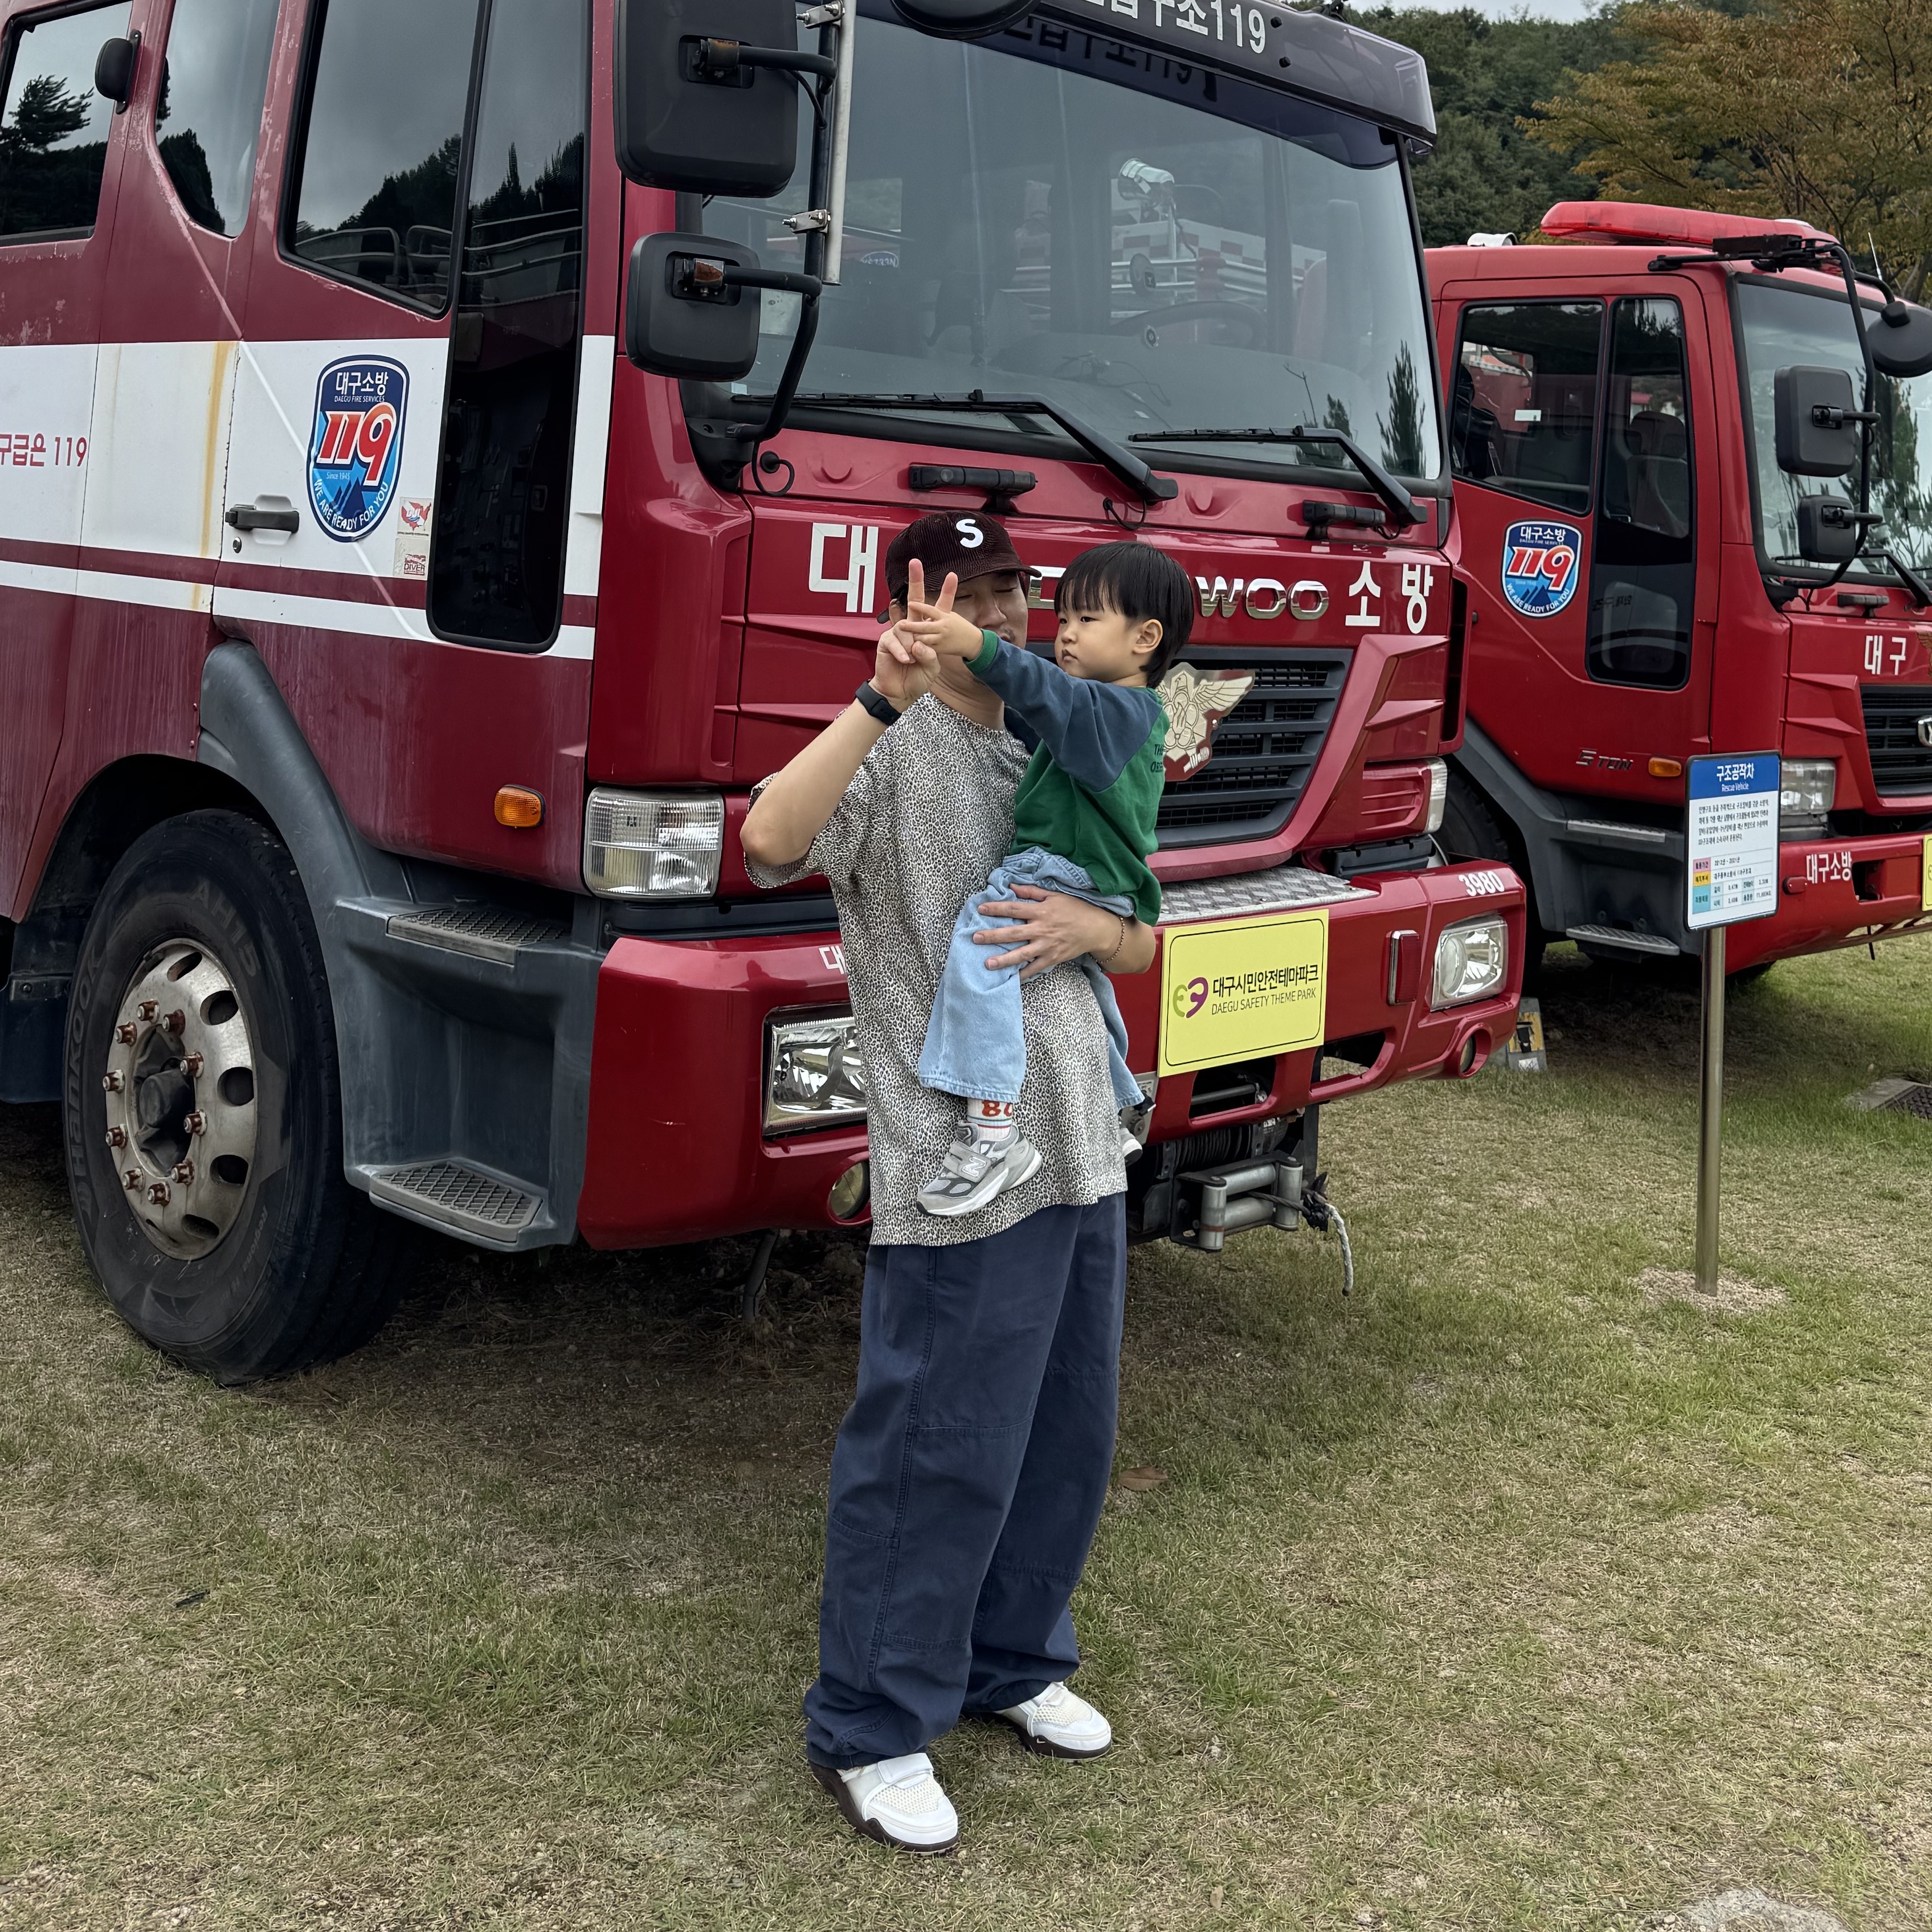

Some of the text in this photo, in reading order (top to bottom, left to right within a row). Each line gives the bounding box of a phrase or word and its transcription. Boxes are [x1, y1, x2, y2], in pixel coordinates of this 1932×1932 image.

[335, 371, 389, 395] 대구소방
[55, 437, 87, 467] 119
[316, 402, 397, 486] 119
[314, 479, 389, 530] WE ARE READY FOR YOU
[955, 518, 984, 548] S
[1520, 526, 1566, 542] 대구소방
[809, 522, 879, 613] 대
[1506, 545, 1575, 591] 119
[1506, 582, 1570, 613] WE ARE READY FOR YOU
[1864, 635, 1906, 676] 대구
[1575, 750, 1634, 771] 5 TON
[1716, 762, 1754, 782] 구조공작차
[1721, 783, 1735, 792] Rescue
[1806, 851, 1852, 884] 대구소방
[1458, 870, 1505, 897] 3980
[1212, 964, 1319, 998] 대구시민안전테마파크
[1211, 987, 1316, 1015] DAEGU SAFETY THEME PARK
